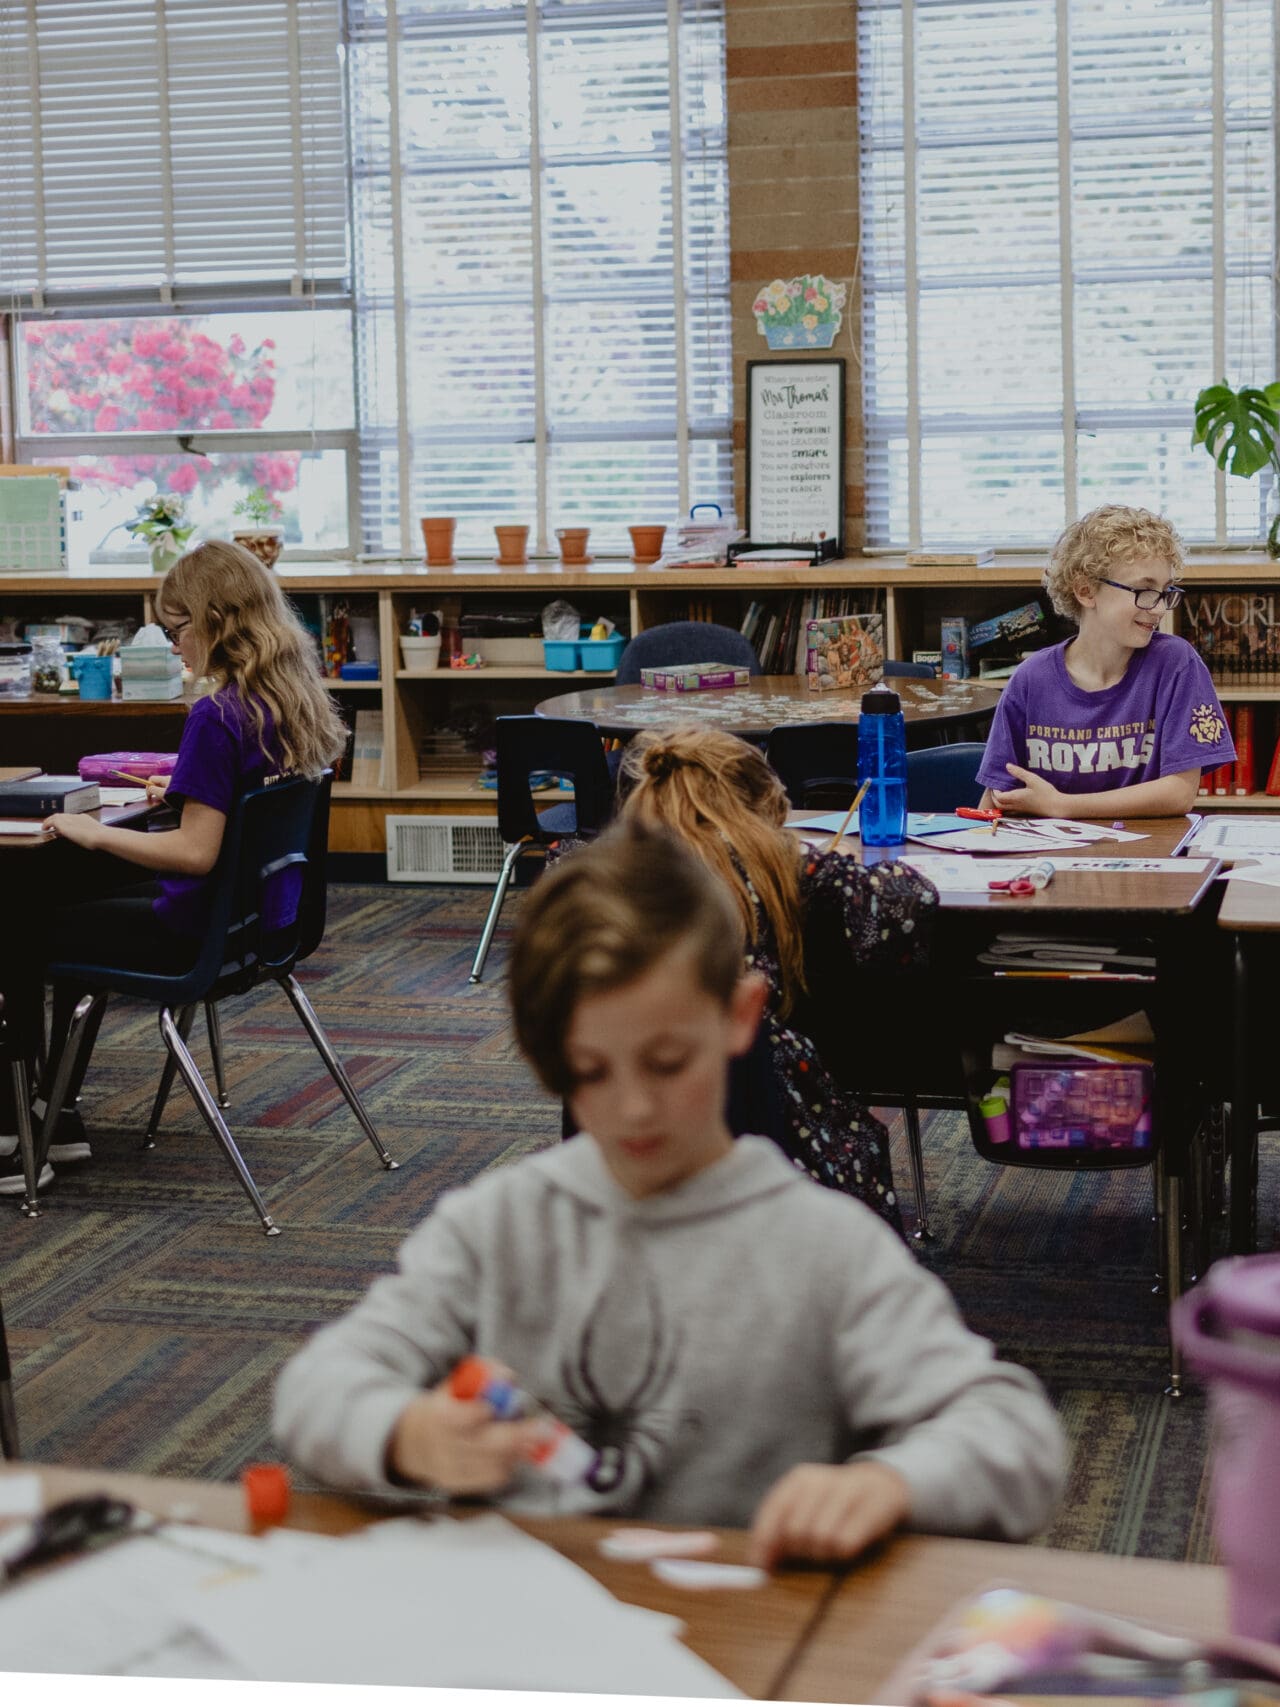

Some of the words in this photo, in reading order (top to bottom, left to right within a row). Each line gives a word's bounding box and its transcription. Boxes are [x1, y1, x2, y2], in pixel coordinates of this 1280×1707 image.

[764, 409, 827, 420] Classroom
[790, 472, 830, 482] explorers
[1029, 724, 1092, 740] PORTLAND
[1097, 719, 1156, 739] CHRISTIN
[1026, 733, 1155, 773] ROYALS
